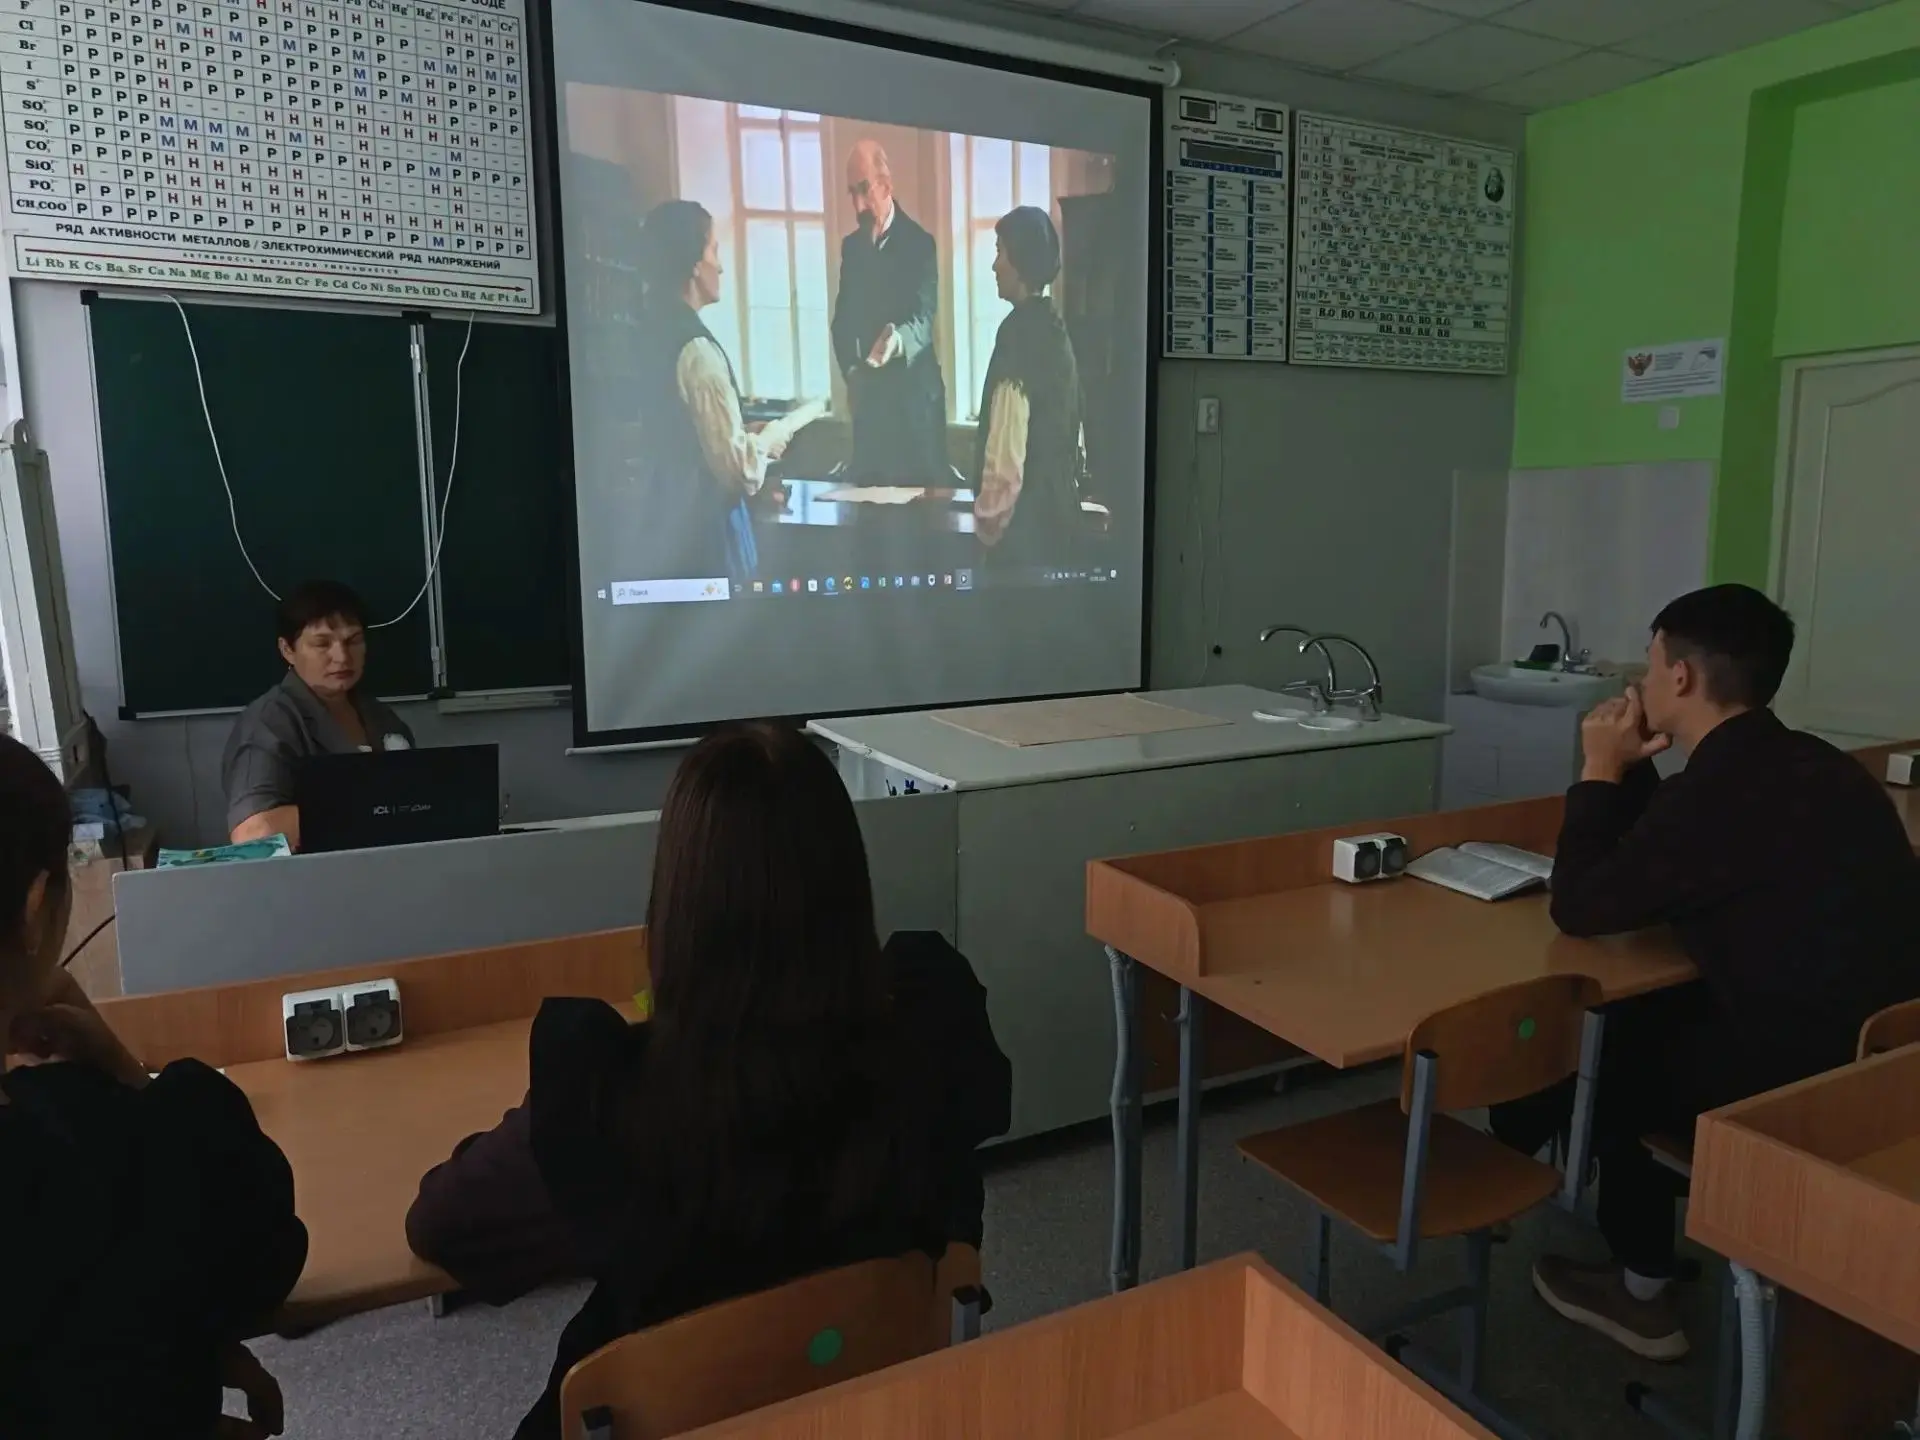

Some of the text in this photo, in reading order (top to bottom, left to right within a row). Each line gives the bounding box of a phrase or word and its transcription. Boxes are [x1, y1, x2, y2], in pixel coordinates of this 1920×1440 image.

[56, 223, 84, 236] РЯД
[90, 227, 177, 242] АКТИВНОСТИ
[182, 234, 250, 248] МЕТАЛЛОВ
[262, 240, 394, 260] ЭЛЕКТРОХИМИЧЕСКИЙ
[400, 253, 422, 264] РЯД
[428, 256, 501, 270] НАПРЯЖЕНИЙ
